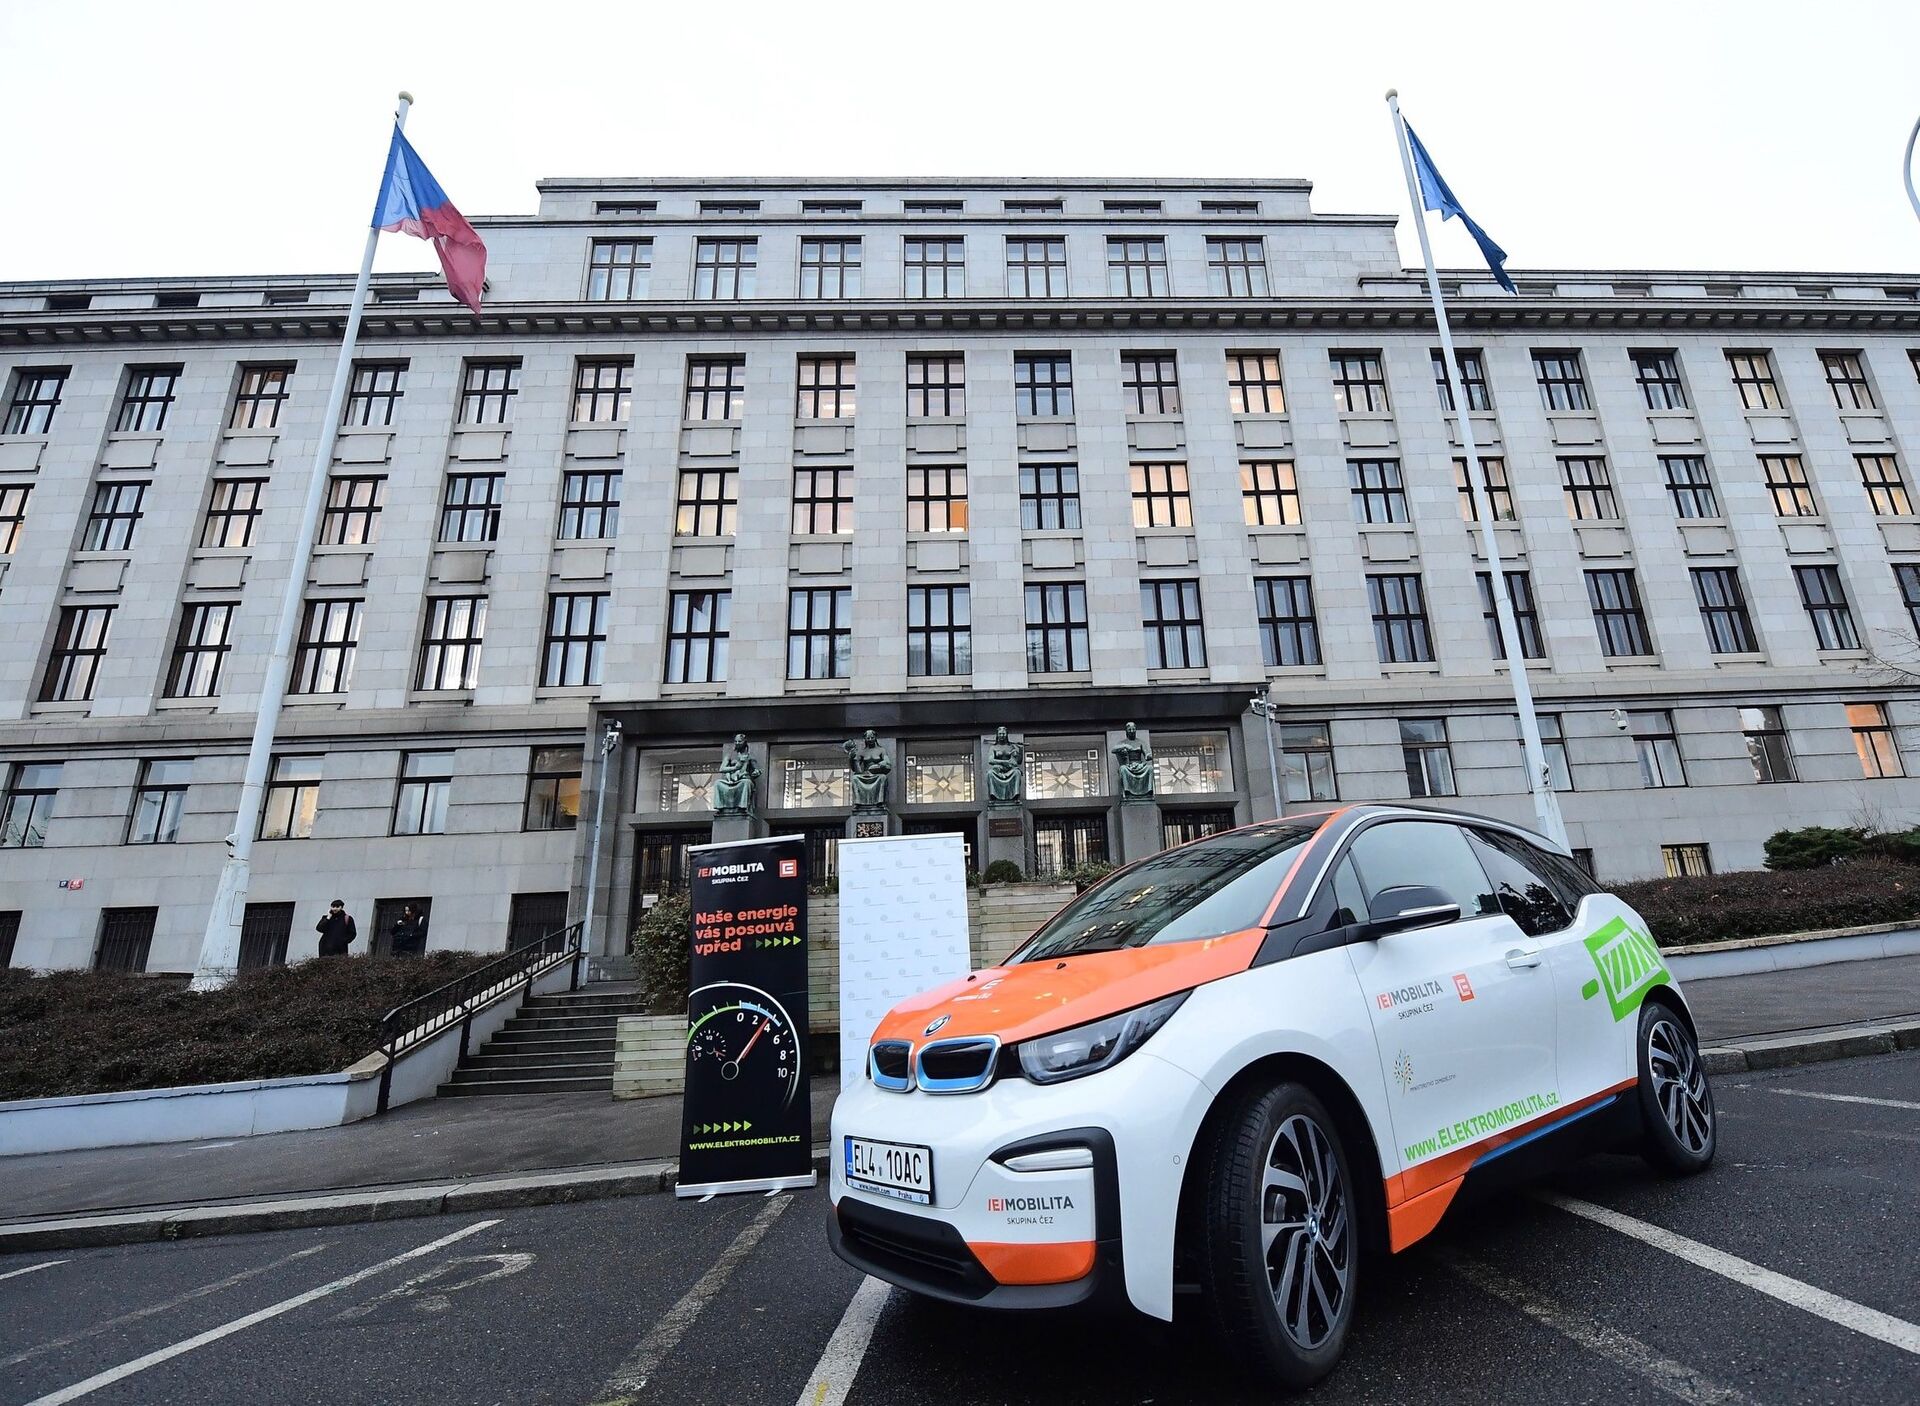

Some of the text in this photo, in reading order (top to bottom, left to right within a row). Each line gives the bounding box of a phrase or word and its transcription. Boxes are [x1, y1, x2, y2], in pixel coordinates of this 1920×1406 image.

[711, 877, 736, 885] SKUPINA
[695, 904, 798, 925] Naše energie
[695, 918, 795, 940] vás posouvá
[694, 938, 742, 956] vpřed
[736, 1012, 744, 1022] 0
[1398, 1003, 1434, 1020] SKUPINA ČEZ
[752, 1015, 759, 1025] 2
[763, 1022, 771, 1033] 4
[773, 1034, 780, 1045] 6
[780, 1050, 787, 1061] 8
[777, 1067, 788, 1078] 10
[689, 1135, 800, 1151] WWW.ELEKTROMOBILITA.CZ
[854, 1144, 922, 1185] EL4 10AC
[1006, 1215, 1054, 1225] SKUPINA ČEZ
